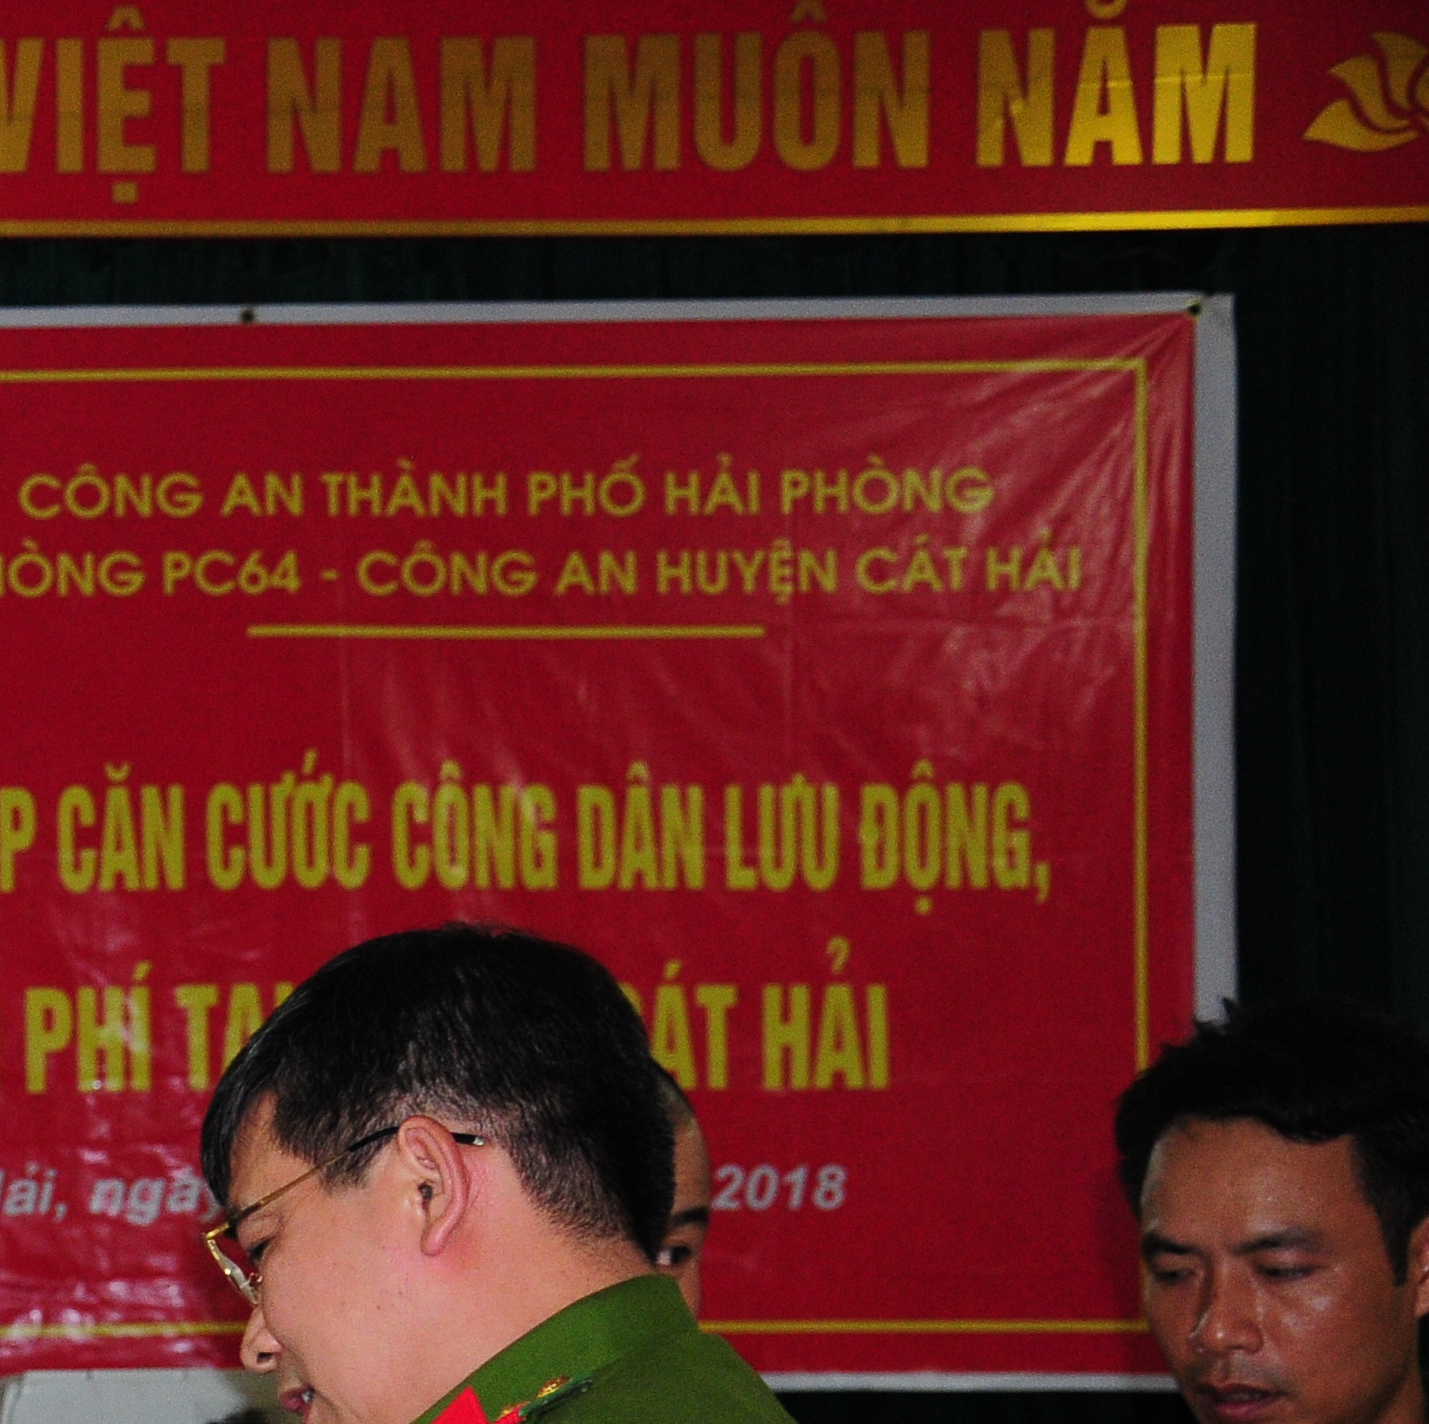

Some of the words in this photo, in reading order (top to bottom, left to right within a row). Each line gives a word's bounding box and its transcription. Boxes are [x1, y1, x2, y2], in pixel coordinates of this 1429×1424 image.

[266, 36, 537, 173] NAM
[583, 0, 930, 171] MUÔN
[975, 0, 1257, 168] NĂM
[18, 464, 203, 519] CÔNG
[221, 474, 304, 517] AN
[323, 457, 507, 517] THÀNH
[528, 455, 645, 517] PHỐ
[664, 453, 761, 515] HẢI
[782, 457, 996, 515] PHÒNG
[163, 551, 301, 595] PC64
[356, 540, 537, 596] CÔNG
[555, 551, 636, 595] AN
[657, 538, 837, 605] HUYỆN
[856, 533, 967, 594] CÁT
[985, 527, 1081, 593] HẢI
[58, 762, 184, 894] CĂN
[206, 749, 370, 890] CƯỚC
[392, 760, 556, 890] CÔNG
[577, 760, 705, 890] DÂN
[725, 772, 839, 890] LƯU
[860, 760, 1050, 914] ĐỘNG,
[24, 961, 151, 1093] PHÍ
[619, 960, 738, 1090] ÁT
[762, 936, 890, 1090] HẢI
[712, 1165, 846, 1210] 2018
